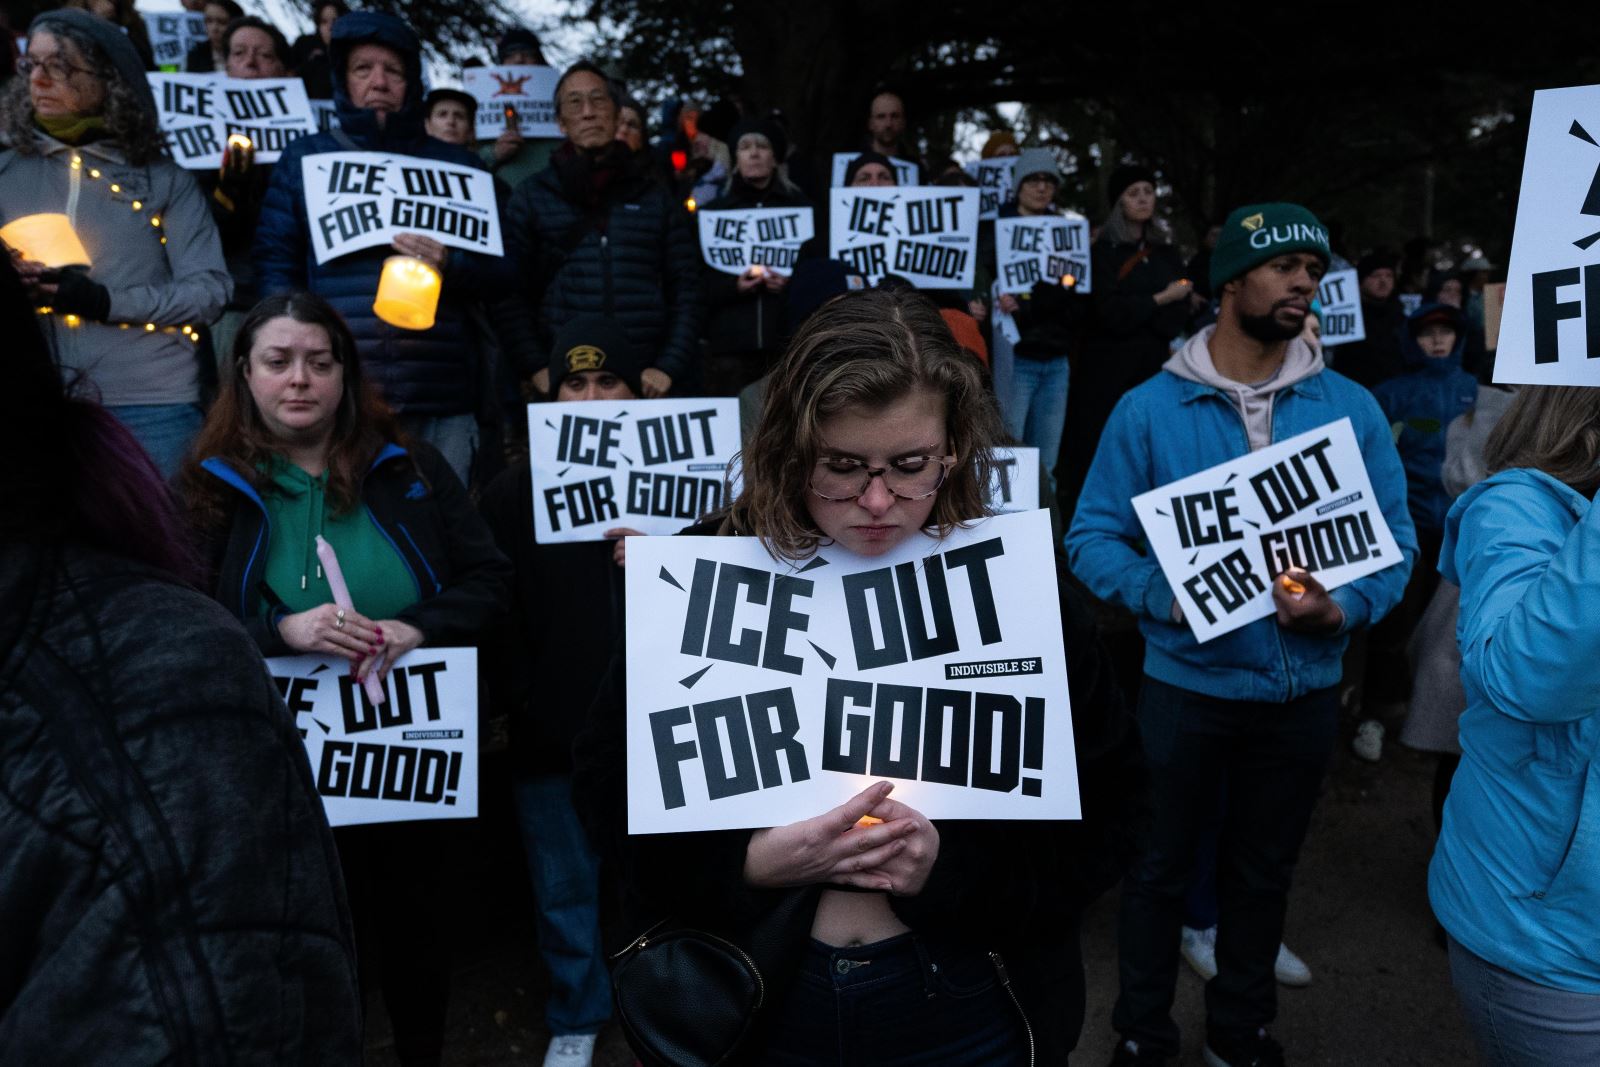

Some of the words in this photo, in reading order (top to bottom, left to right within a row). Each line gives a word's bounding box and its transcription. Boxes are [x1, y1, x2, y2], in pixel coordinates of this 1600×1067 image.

[163, 81, 215, 119] ICE
[225, 86, 288, 120] OUT
[328, 161, 387, 195] ICE
[402, 167, 473, 201] OUT
[319, 201, 383, 249] FOR
[391, 198, 488, 246] GOOD!
[714, 217, 748, 243] ICE
[757, 214, 800, 242] OUT
[849, 196, 895, 237] ICE
[906, 195, 964, 236] OUT
[708, 247, 746, 267] FOR
[1011, 225, 1043, 253] ICE
[1052, 225, 1082, 251] OUT
[1250, 223, 1330, 251] GUINN
[894, 240, 968, 281] GOOD!
[1004, 258, 1042, 287] FOR
[1319, 277, 1345, 307] UT
[556, 414, 622, 469] ICE
[636, 409, 717, 466] OUT
[543, 476, 619, 532] FOR
[1171, 487, 1244, 549] ICE
[1249, 437, 1340, 525] OUT
[1183, 547, 1266, 626] FOR
[1260, 510, 1382, 582] GOOD!
[680, 558, 815, 676] ICE
[841, 536, 1005, 671] OUT
[949, 662, 1019, 677] INDIVISIBLE
[1021, 660, 1037, 672] SF
[338, 661, 447, 734] OUT
[648, 686, 811, 811] FOR
[821, 677, 1046, 798] GOOD!
[317, 740, 463, 806] GOOD!
